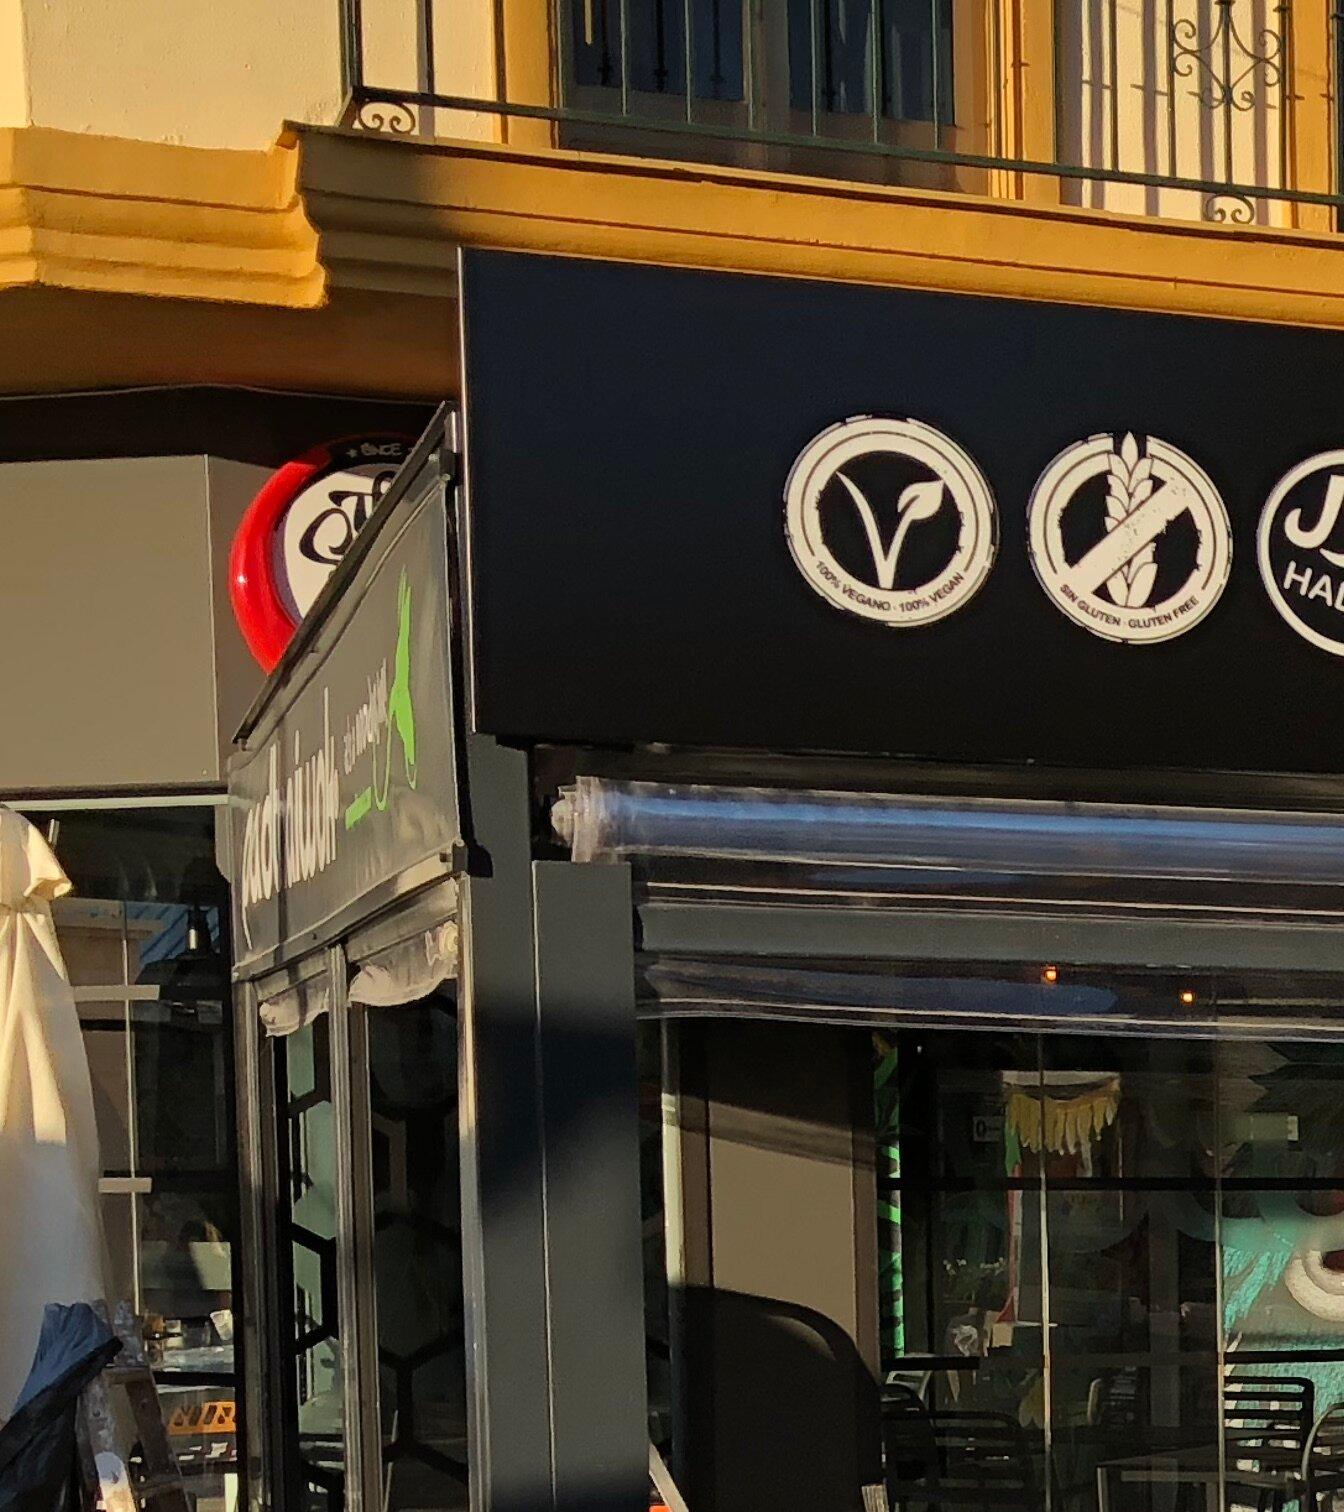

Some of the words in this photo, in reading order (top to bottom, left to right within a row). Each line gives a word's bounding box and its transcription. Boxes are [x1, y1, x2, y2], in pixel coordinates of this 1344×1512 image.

[815, 560, 842, 589] 100%
[842, 583, 891, 611] VEGANO
[898, 598, 930, 613] 100%
[929, 571, 965, 603] VEGAN
[1060, 584, 1078, 603] SIN
[1077, 599, 1122, 626] GLUTEN
[1128, 612, 1173, 629] GLUTEN
[1173, 595, 1200, 619] FREE
